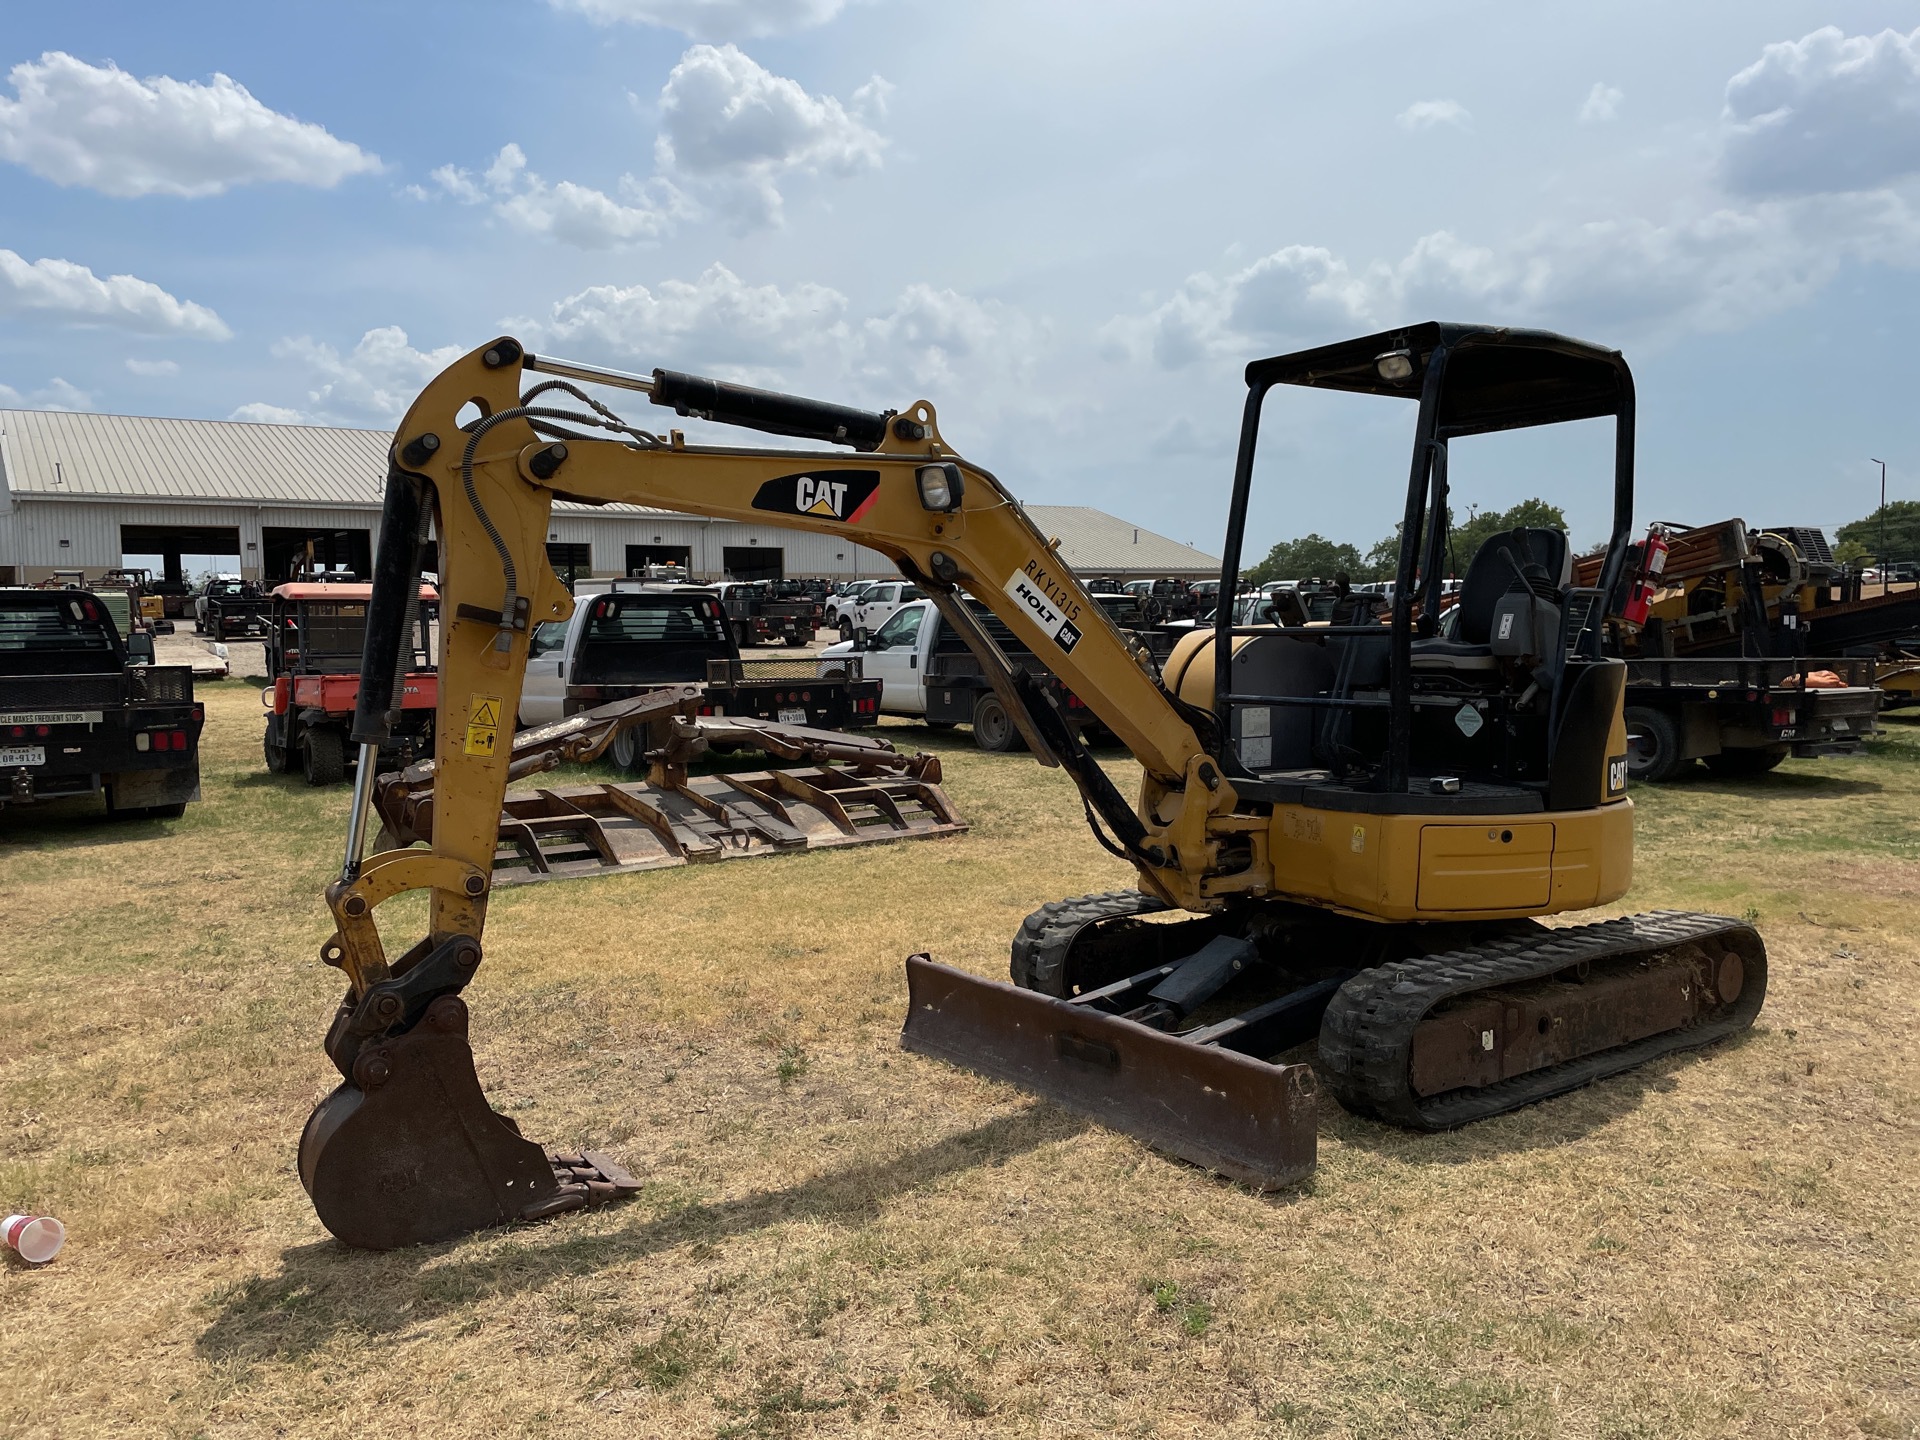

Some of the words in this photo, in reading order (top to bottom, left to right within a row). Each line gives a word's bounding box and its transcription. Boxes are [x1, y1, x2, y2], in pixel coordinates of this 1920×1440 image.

[795, 476, 848, 518] CAT
[1024, 558, 1082, 621] RKY1315
[1015, 583, 1058, 625] HOLT
[1059, 627, 1077, 646] CAT
[12, 715, 34, 723] MAKES
[35, 714, 64, 723] FREQUENT
[65, 713, 84, 722] STOPS
[1609, 761, 1625, 791] CAT
